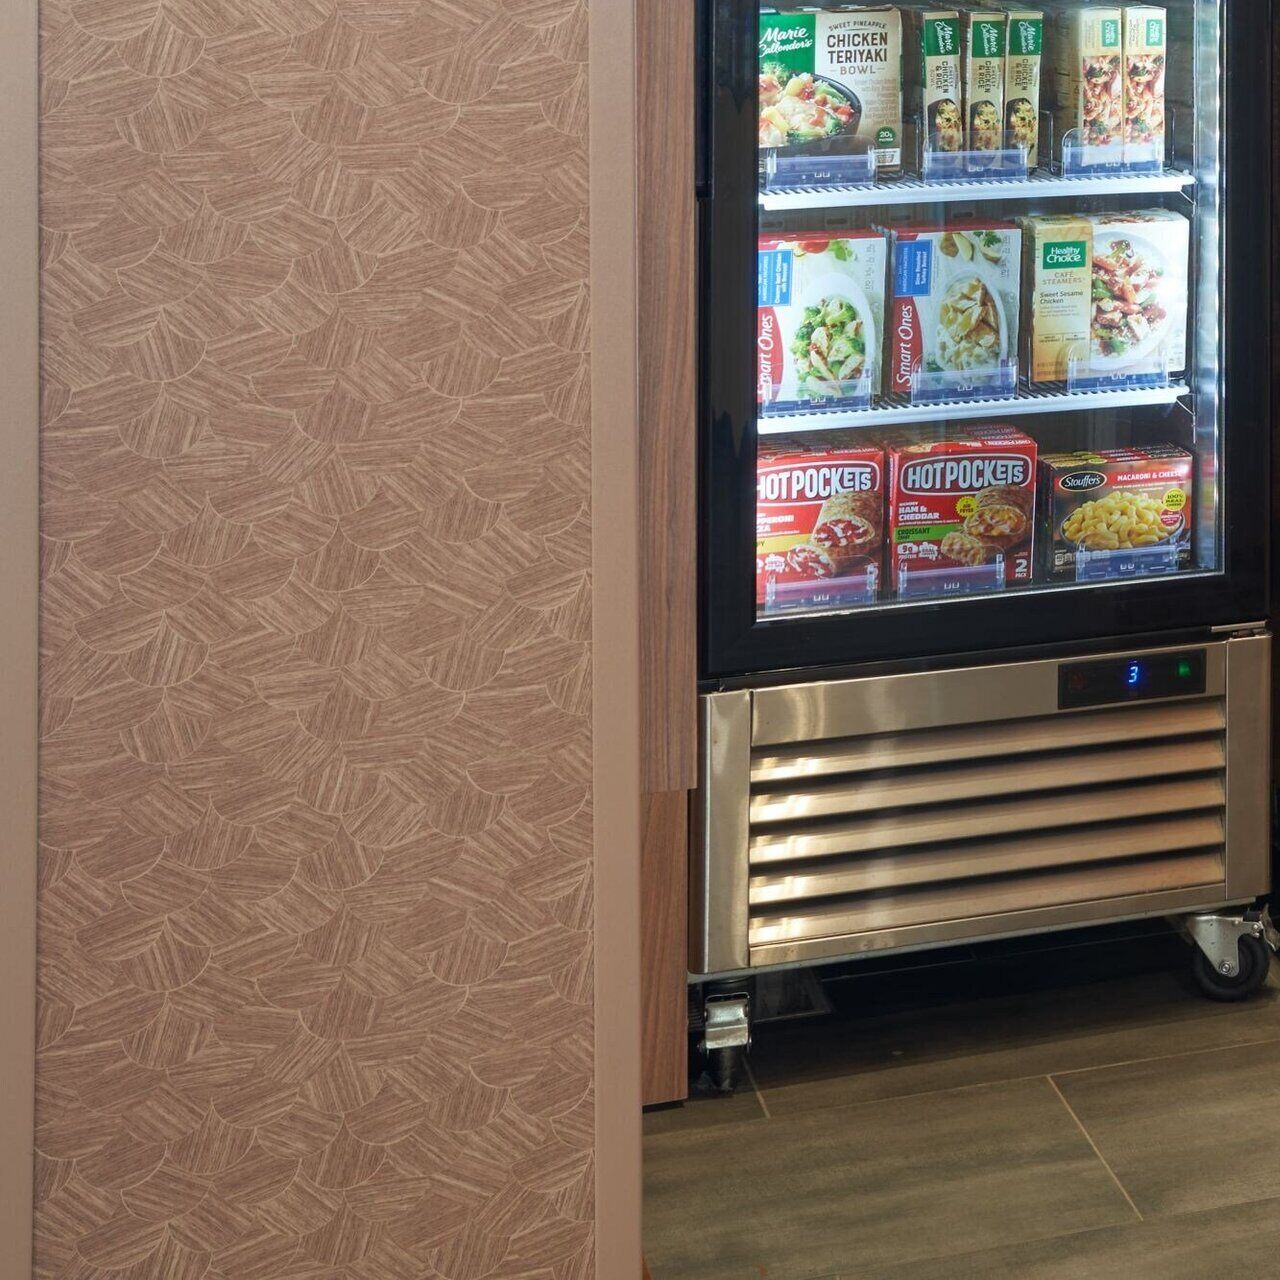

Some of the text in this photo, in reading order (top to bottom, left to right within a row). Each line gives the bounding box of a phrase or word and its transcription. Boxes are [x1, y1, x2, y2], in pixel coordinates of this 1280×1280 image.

[829, 21, 887, 31] SWEET PINEAPPLE
[760, 27, 808, 44] Marie
[827, 33, 888, 48] CHICKEN
[759, 39, 813, 57] Callender's
[828, 48, 887, 63] TERIYAKI
[840, 67, 876, 75] BOWL
[1047, 254, 1082, 263] Choice
[759, 315, 774, 350] Ones
[897, 305, 913, 386] Smart Ones
[908, 459, 1024, 489] HOT POCKETS
[1065, 475, 1100, 487] Stouffer's
[792, 468, 872, 499] POCKETS
[898, 527, 930, 535] CROISSANT
[1016, 558, 1028, 572] 2
